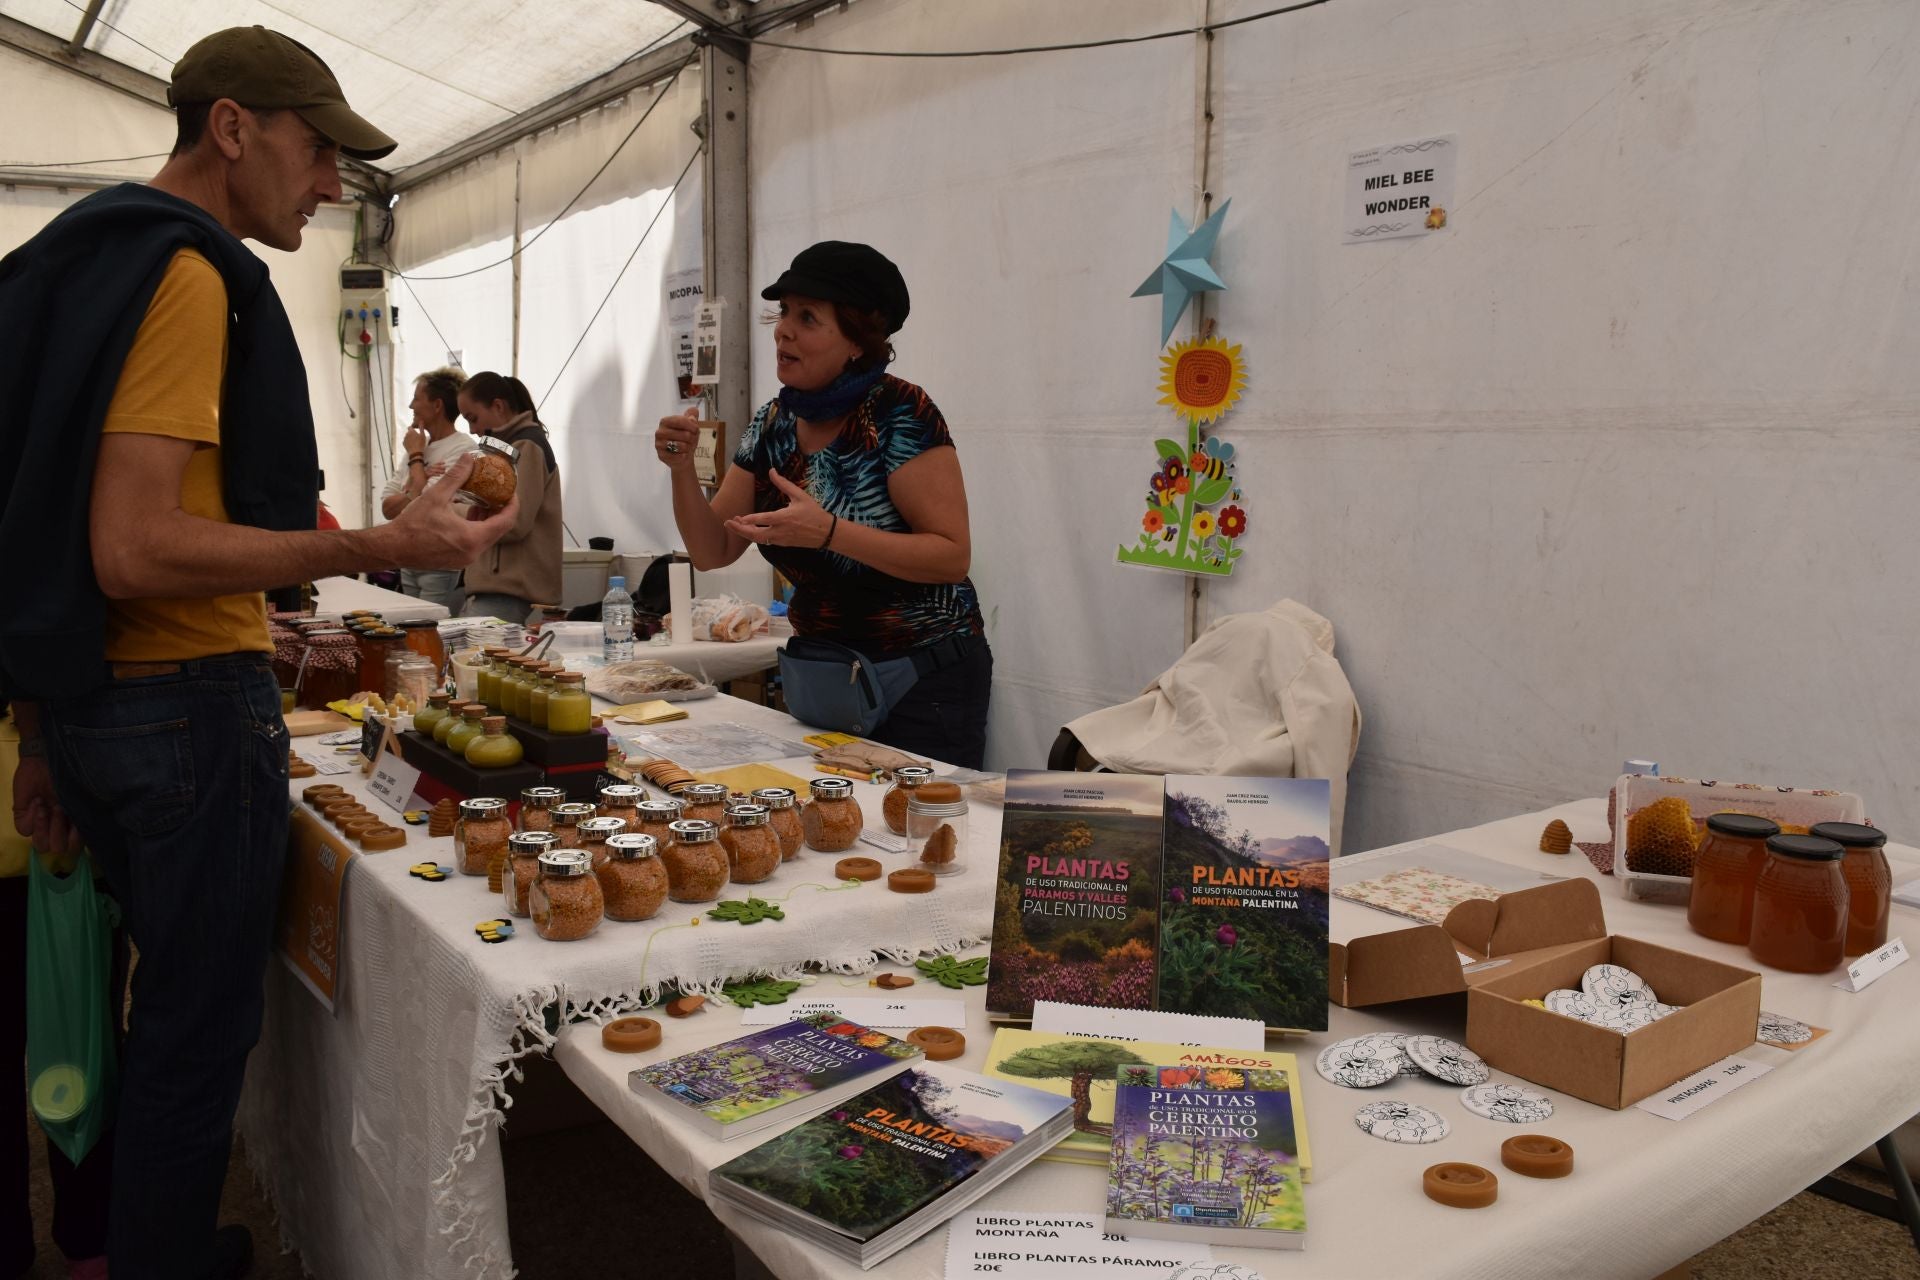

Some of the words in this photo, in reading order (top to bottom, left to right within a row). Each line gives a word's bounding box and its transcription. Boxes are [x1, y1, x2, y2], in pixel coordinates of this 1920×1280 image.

[1365, 174, 1398, 191] MIEL
[1402, 169, 1434, 184] BEE
[1365, 196, 1430, 216] WONDER
[669, 285, 703, 300] MICOPAL
[1026, 856, 1130, 880] PLANTAS
[1193, 866, 1300, 888] PLANTAS
[1026, 878, 1036, 886] DE
[1040, 879, 1056, 887] USO
[1058, 880, 1114, 891] TRADICIONAL
[1116, 884, 1128, 892] EN
[1223, 888, 1274, 897] TRADICIONAL
[1025, 886, 1075, 900] PÁRAMOS
[1078, 892, 1085, 900] Y
[1088, 893, 1127, 904] VALLES
[1192, 896, 1240, 907] MONTAÑA
[1242, 900, 1298, 910] PALENTINA
[1024, 900, 1126, 920] PALENTINOS
[774, 1040, 842, 1068] CERRATO
[797, 1030, 868, 1060] PLANTAS
[758, 1044, 826, 1074] PALENTINO
[1180, 1054, 1272, 1068] AMIGOS
[1150, 1092, 1256, 1107] PLANTAS
[1668, 1079, 1718, 1104] PINTACHAPAS
[1149, 1111, 1256, 1126] CERRATO
[864, 1108, 972, 1148] PLANTAS
[867, 1120, 884, 1130] USO
[884, 1126, 933, 1146] TRADICIONAL
[932, 1142, 944, 1150] EN
[944, 1146, 956, 1154] LA
[1149, 1122, 1258, 1138] PALENTINO
[892, 1138, 948, 1160] PALENTINA
[976, 1217, 1020, 1226] LIBRO
[1026, 1218, 1094, 1229] PLANTAS
[976, 1228, 1060, 1238] MONTAÑA
[1102, 1232, 1130, 1242] 20€
[974, 1252, 1020, 1261] LIBRO
[1026, 1254, 1098, 1264] PLANTAS
[973, 1264, 1002, 1273] 20€
